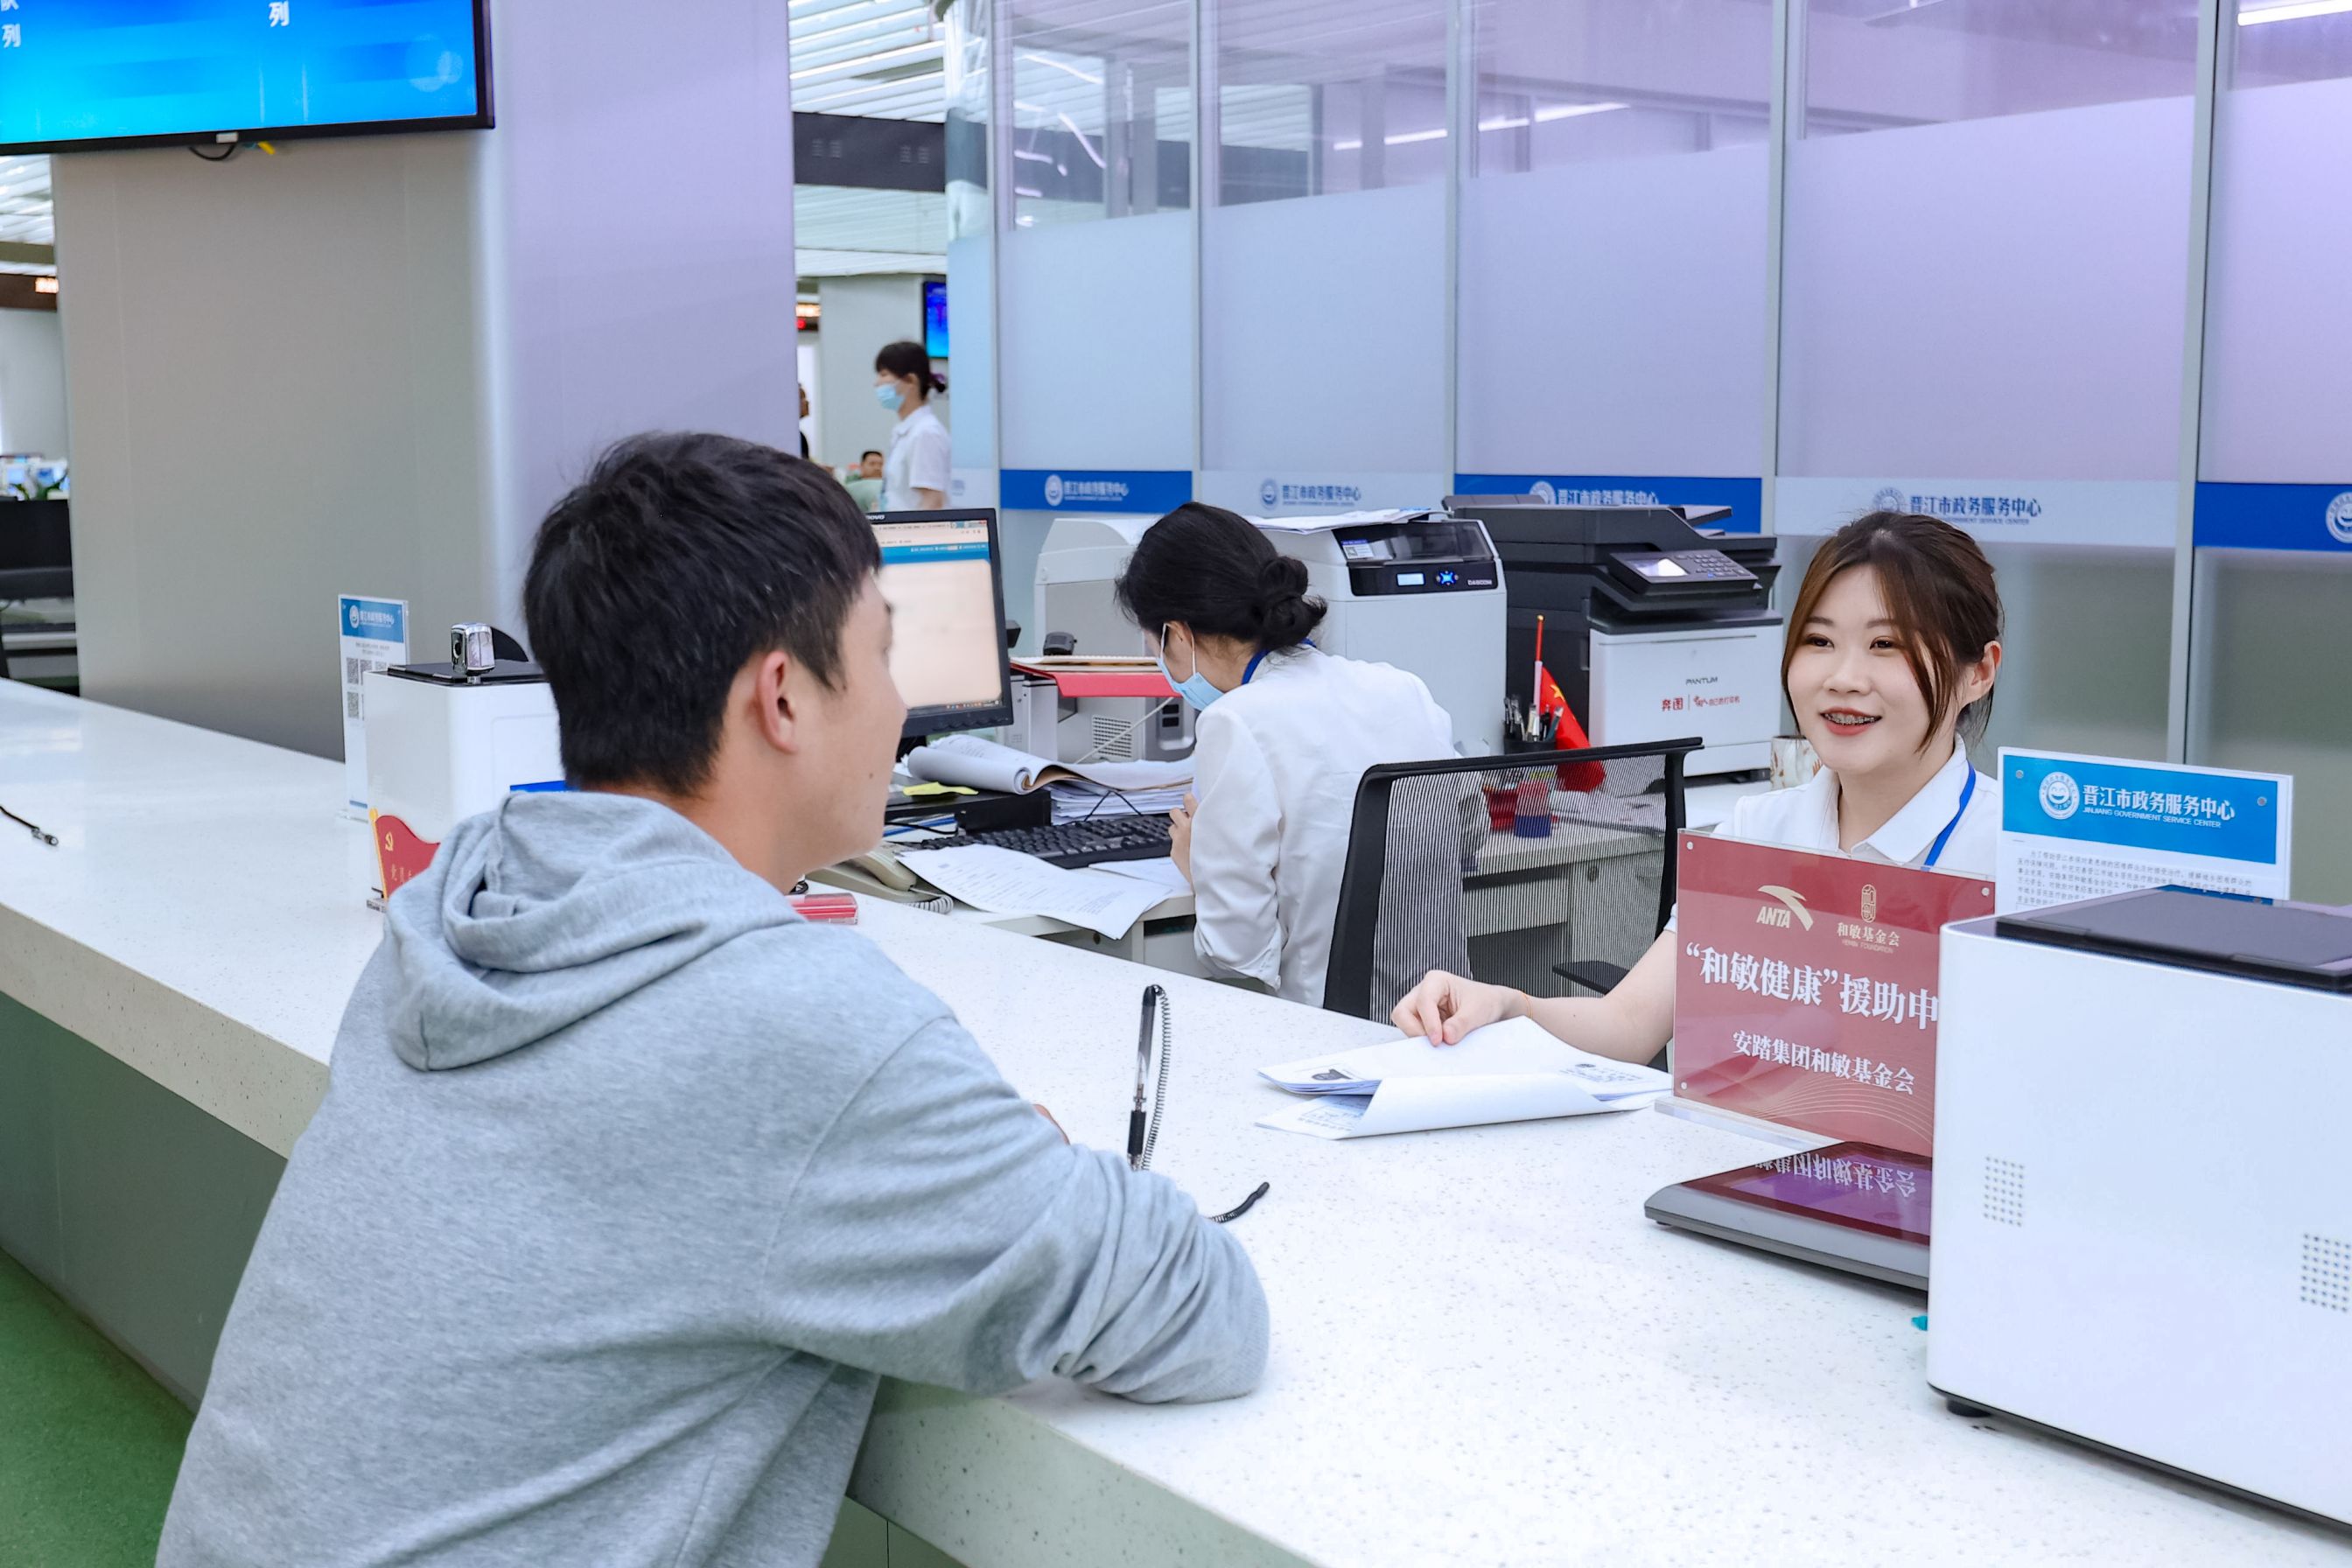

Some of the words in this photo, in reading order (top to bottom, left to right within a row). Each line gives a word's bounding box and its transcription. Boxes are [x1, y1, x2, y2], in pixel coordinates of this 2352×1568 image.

[269, 1, 290, 27] 列
[1910, 495, 2041, 517] 晋江市政务服务中心
[1685, 676, 1718, 685] PANTUM
[2082, 785, 2235, 821] 晋江市政务服务中心
[2113, 809, 2161, 821] GOVERNMENT
[2162, 816, 2192, 825] SERVICE
[2194, 820, 2222, 829] CENTER
[1756, 906, 1791, 928] ANTA
[1838, 921, 1900, 947] 和敏基金会
[1732, 1030, 1915, 1095] 安踏集团和敏基金会
